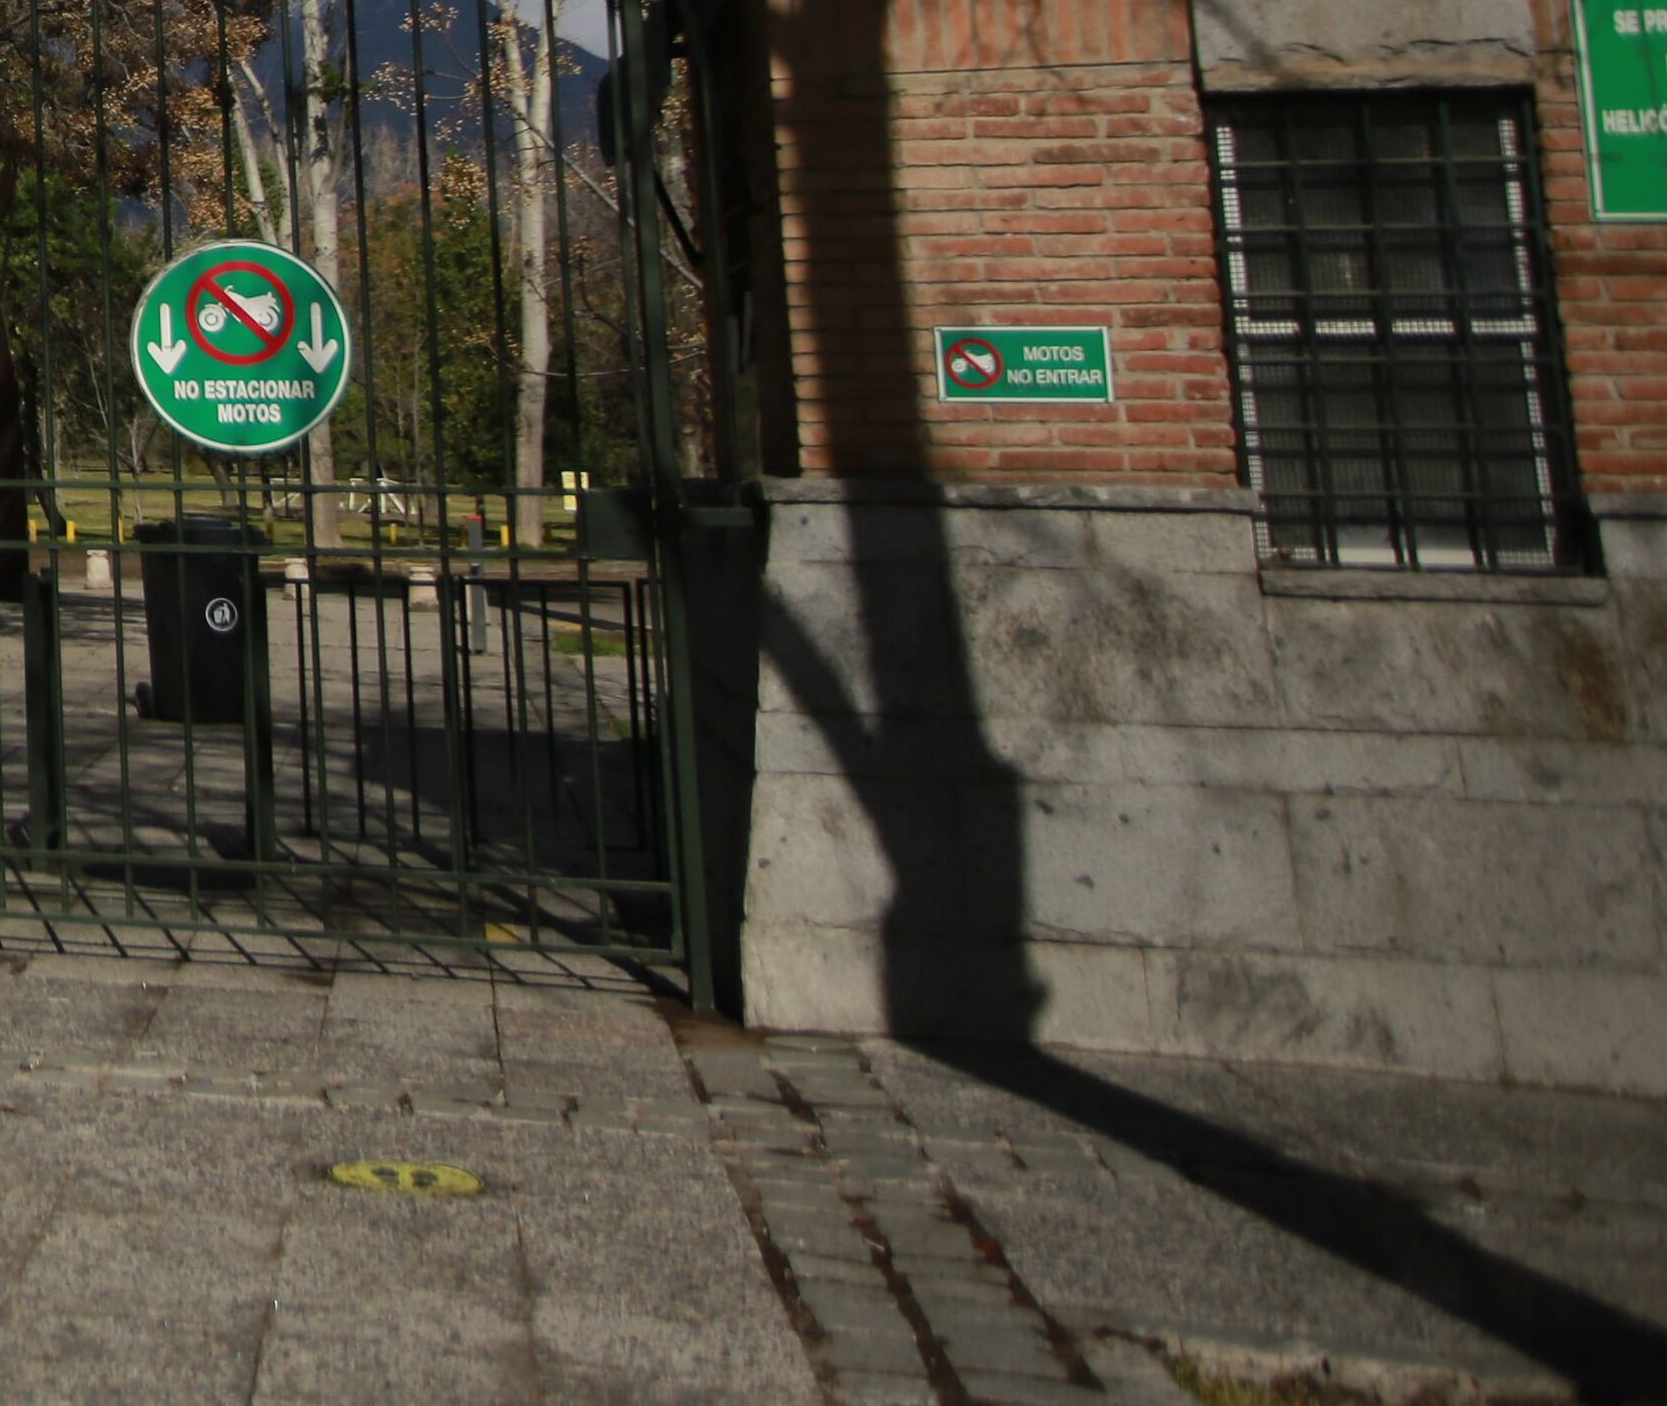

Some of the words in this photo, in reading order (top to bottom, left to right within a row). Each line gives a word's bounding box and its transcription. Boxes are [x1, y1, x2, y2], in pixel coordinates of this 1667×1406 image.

[1613, 9, 1640, 33] SE
[1023, 346, 1084, 361] MOTOS
[1007, 369, 1031, 384] NO
[1036, 369, 1103, 384] ENTRAR
[174, 380, 199, 399] NO
[204, 379, 315, 399] ESTACIONAR
[218, 403, 282, 423] MOTOS
